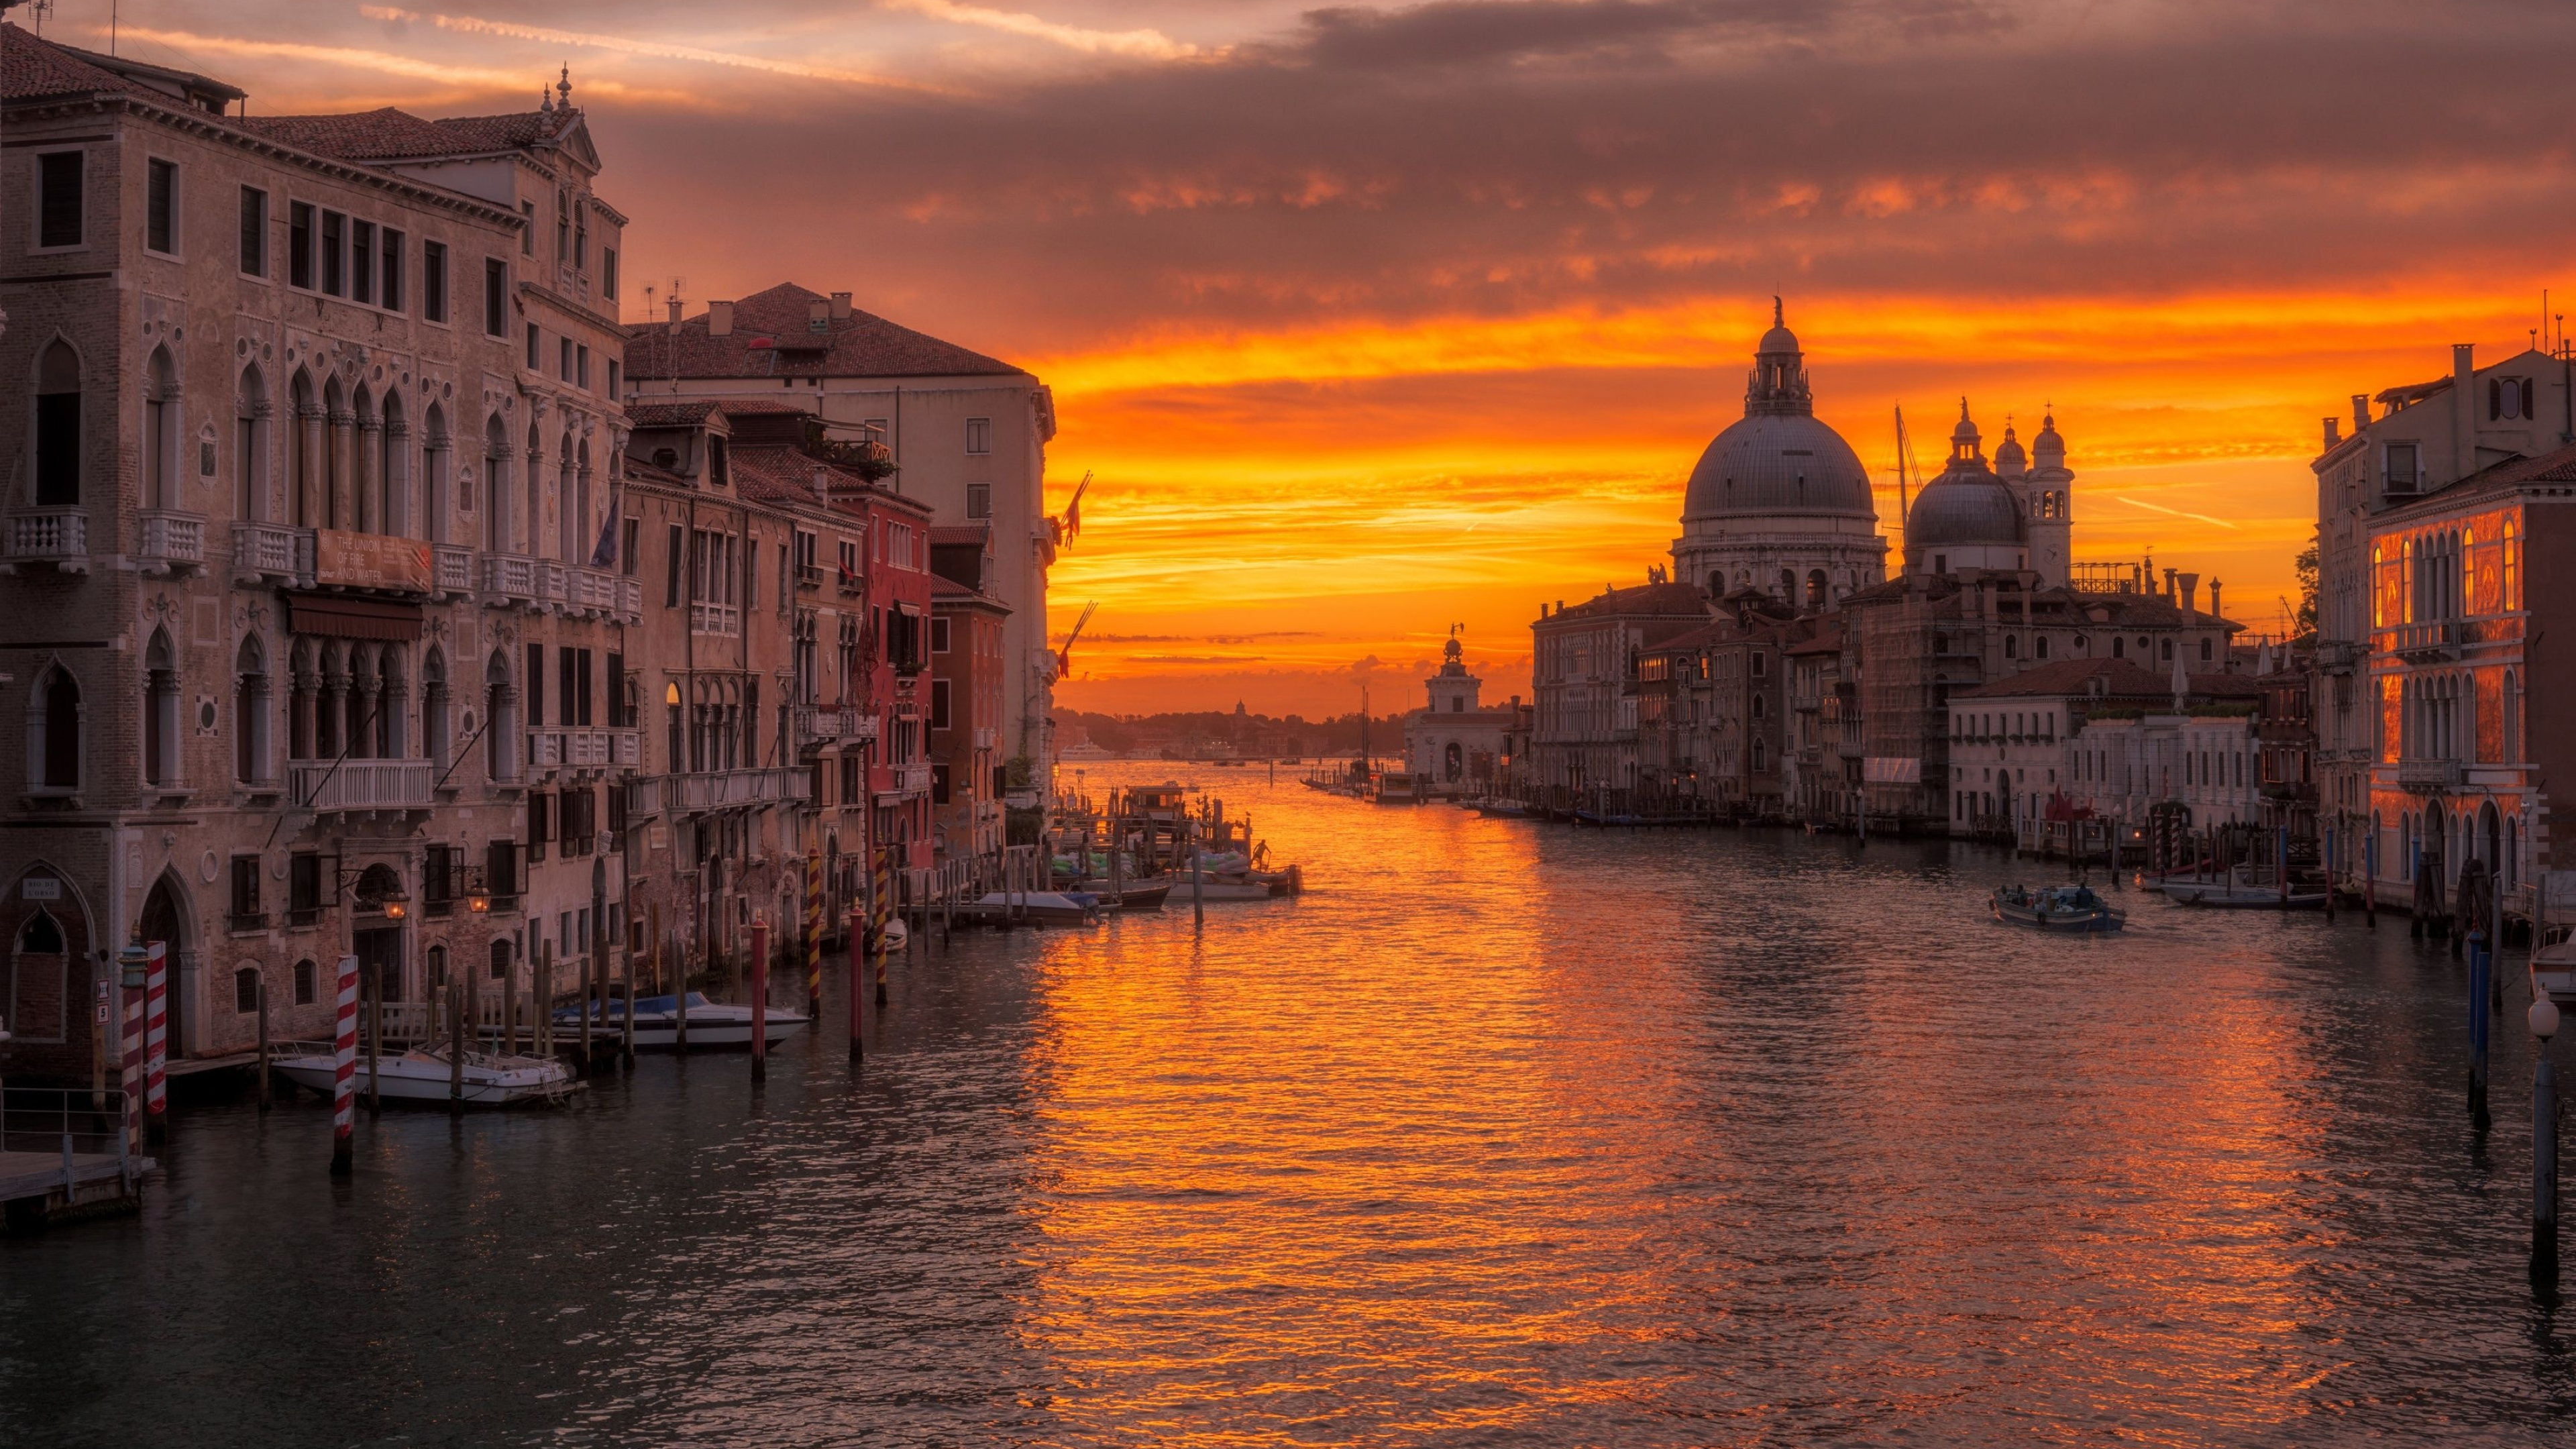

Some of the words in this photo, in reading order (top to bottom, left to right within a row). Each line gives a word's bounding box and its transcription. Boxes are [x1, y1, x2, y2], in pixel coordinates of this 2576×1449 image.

[337, 537, 352, 549] THE
[354, 539, 380, 552] UNION
[337, 552, 347, 564] OF
[350, 553, 364, 566] FIRE
[337, 568, 354, 580] AND
[357, 569, 382, 582] WATER
[101, 1008, 105, 1018] 5
